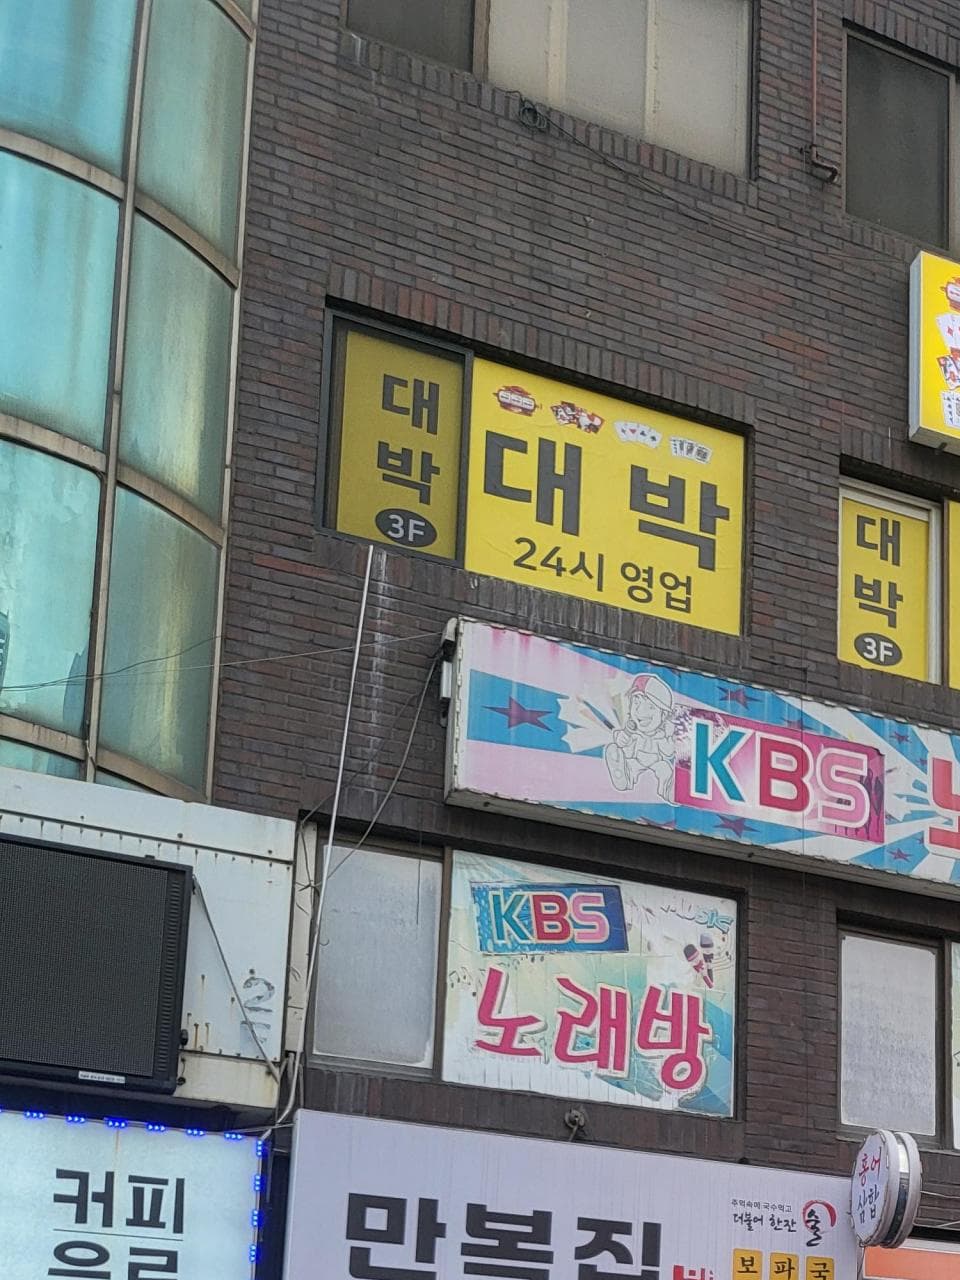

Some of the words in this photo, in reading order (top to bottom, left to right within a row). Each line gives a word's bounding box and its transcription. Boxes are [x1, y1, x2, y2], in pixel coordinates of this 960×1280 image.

[376, 374, 441, 506] 대박
[387, 513, 426, 542] 3F
[483, 430, 731, 571] 대박
[513, 537, 605, 593] 24시
[621, 561, 692, 614] 영업
[854, 514, 904, 629] 대박
[863, 637, 894, 663] 3F
[691, 718, 872, 828] KBS
[491, 889, 610, 946] KBS
[475, 966, 712, 1091] 노래방
[53, 1168, 185, 1234] 커피
[733, 1213, 764, 1232] 더불어
[769, 1214, 797, 1233] 한잔
